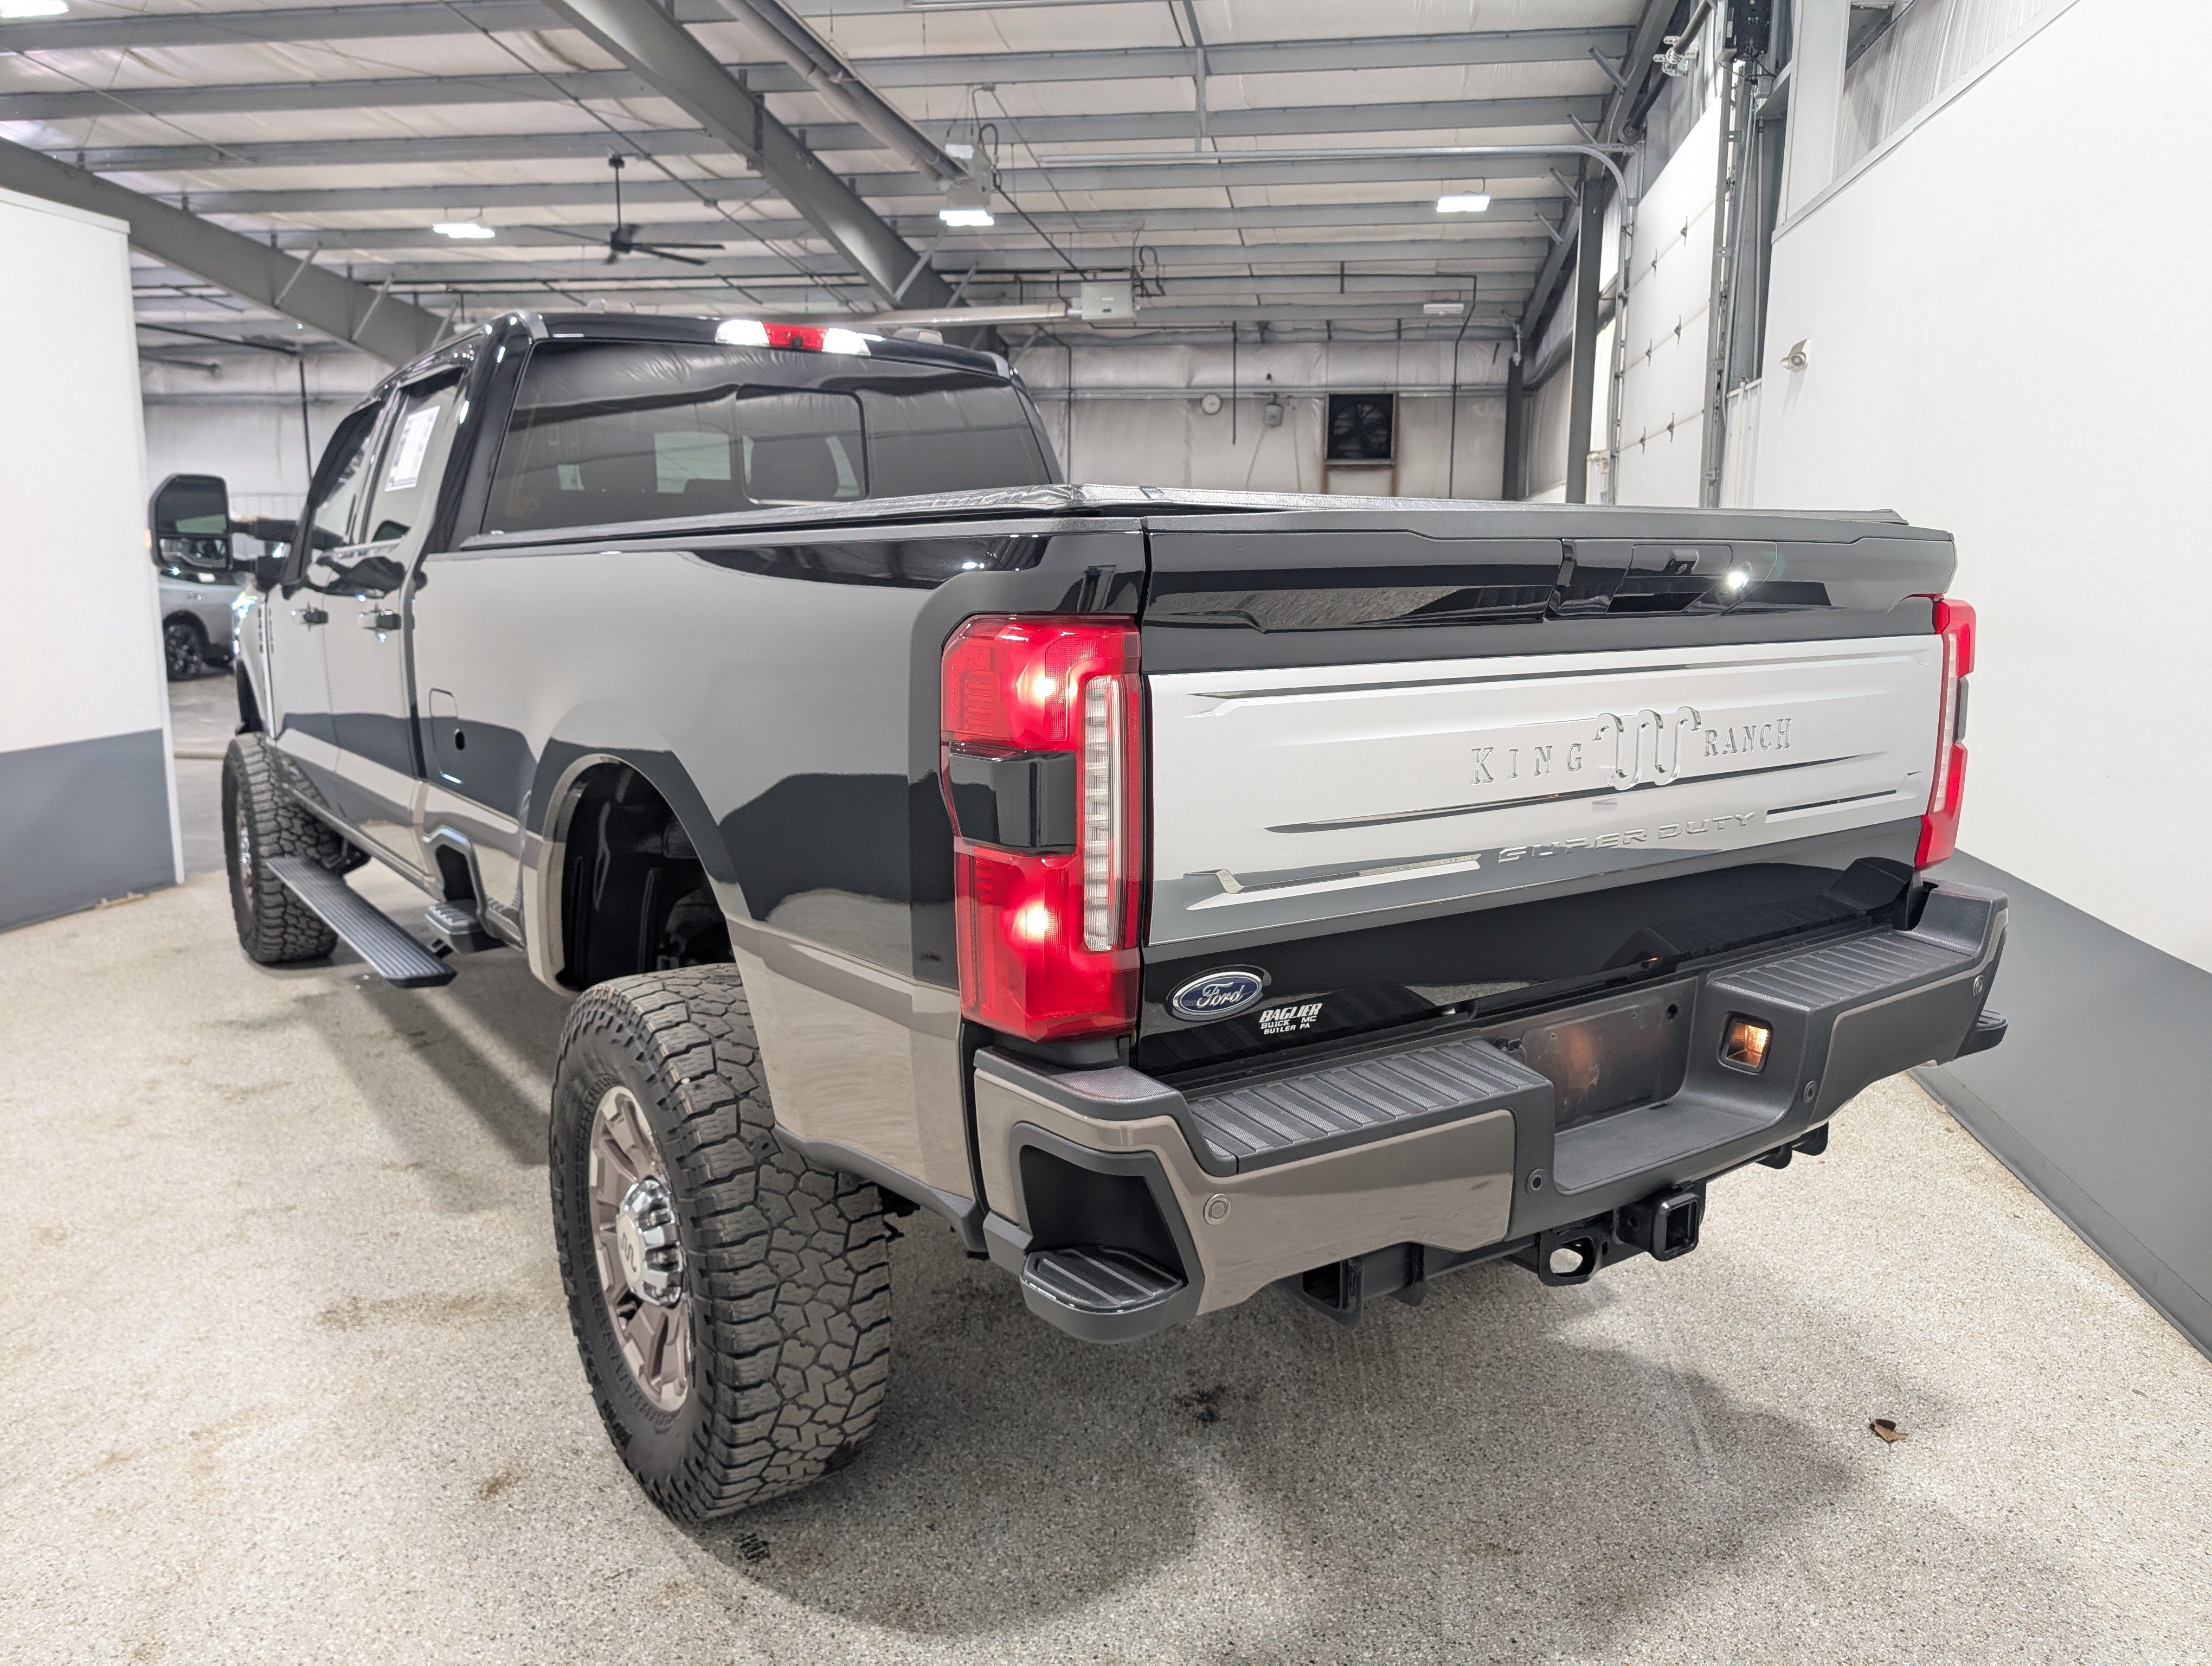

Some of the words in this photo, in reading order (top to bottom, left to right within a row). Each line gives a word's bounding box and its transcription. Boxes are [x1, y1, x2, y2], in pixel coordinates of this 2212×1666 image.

[1470, 742, 1583, 785] KING
[1703, 717, 1792, 758] RANCH
[1497, 828, 1648, 864] SUPER
[1657, 811, 1756, 840] DUTY
[1196, 981, 1246, 1009] Ford
[1258, 1003, 1323, 1023] BAGLIER
[1260, 1019, 1291, 1029] BUICK
[1263, 1024, 1296, 1035] BUTLER
